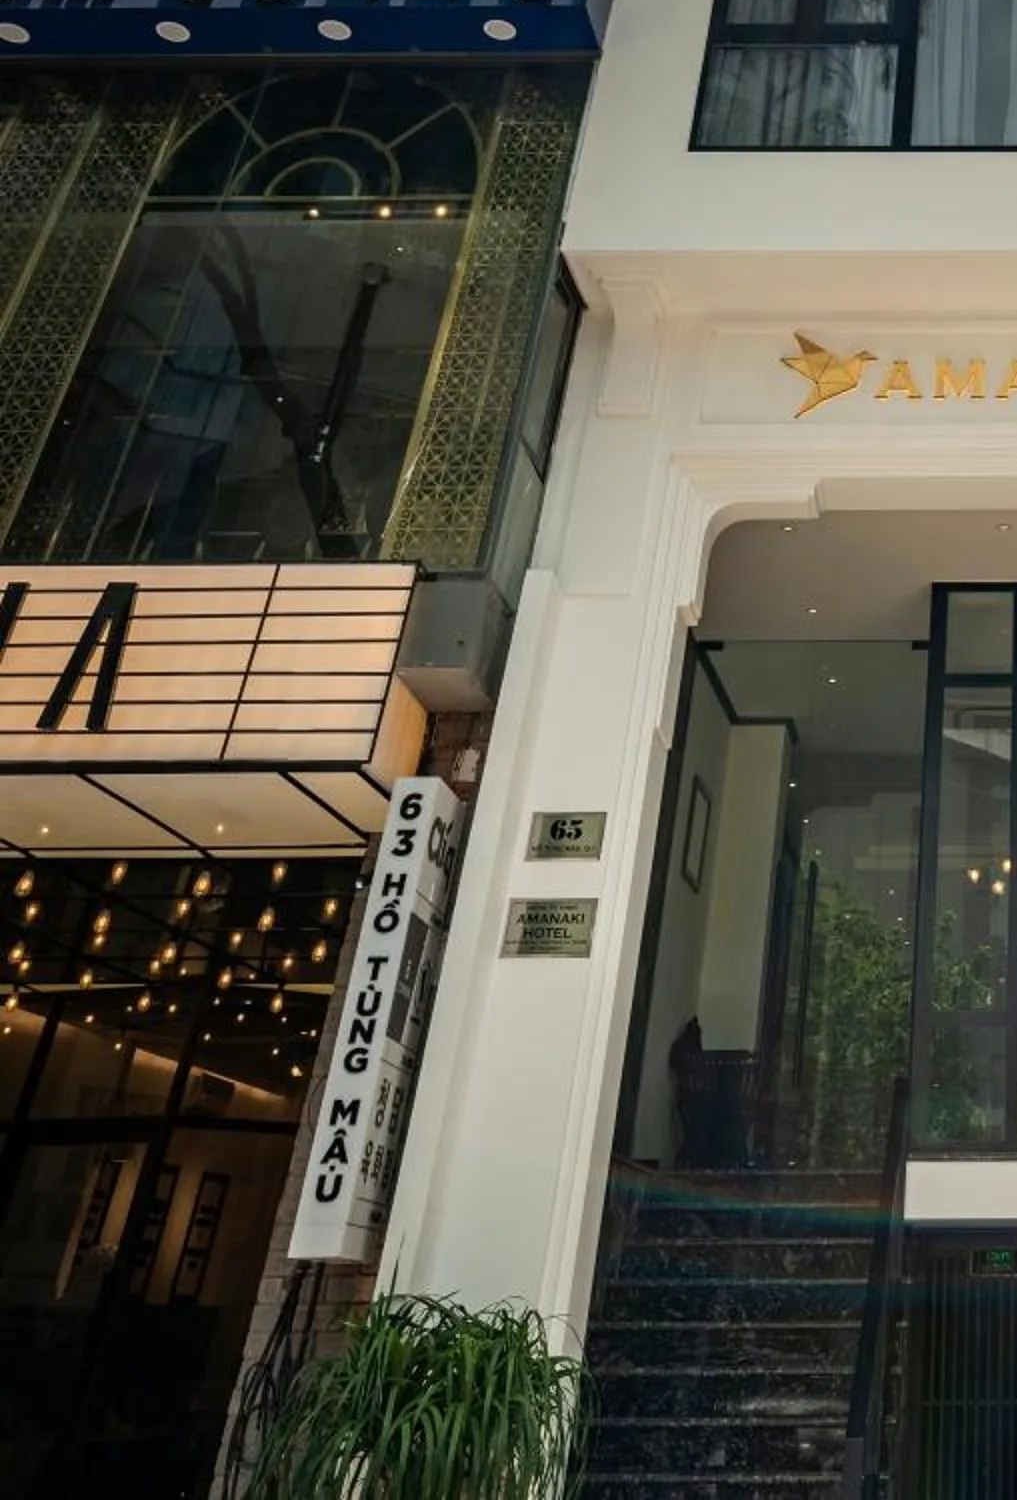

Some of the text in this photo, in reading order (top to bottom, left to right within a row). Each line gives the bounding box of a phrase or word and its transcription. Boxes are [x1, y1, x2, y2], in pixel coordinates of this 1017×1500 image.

[391, 793, 423, 857] 63
[550, 819, 583, 841] 65
[516, 913, 585, 926] AMANAKI
[523, 927, 573, 939] HOTEL
